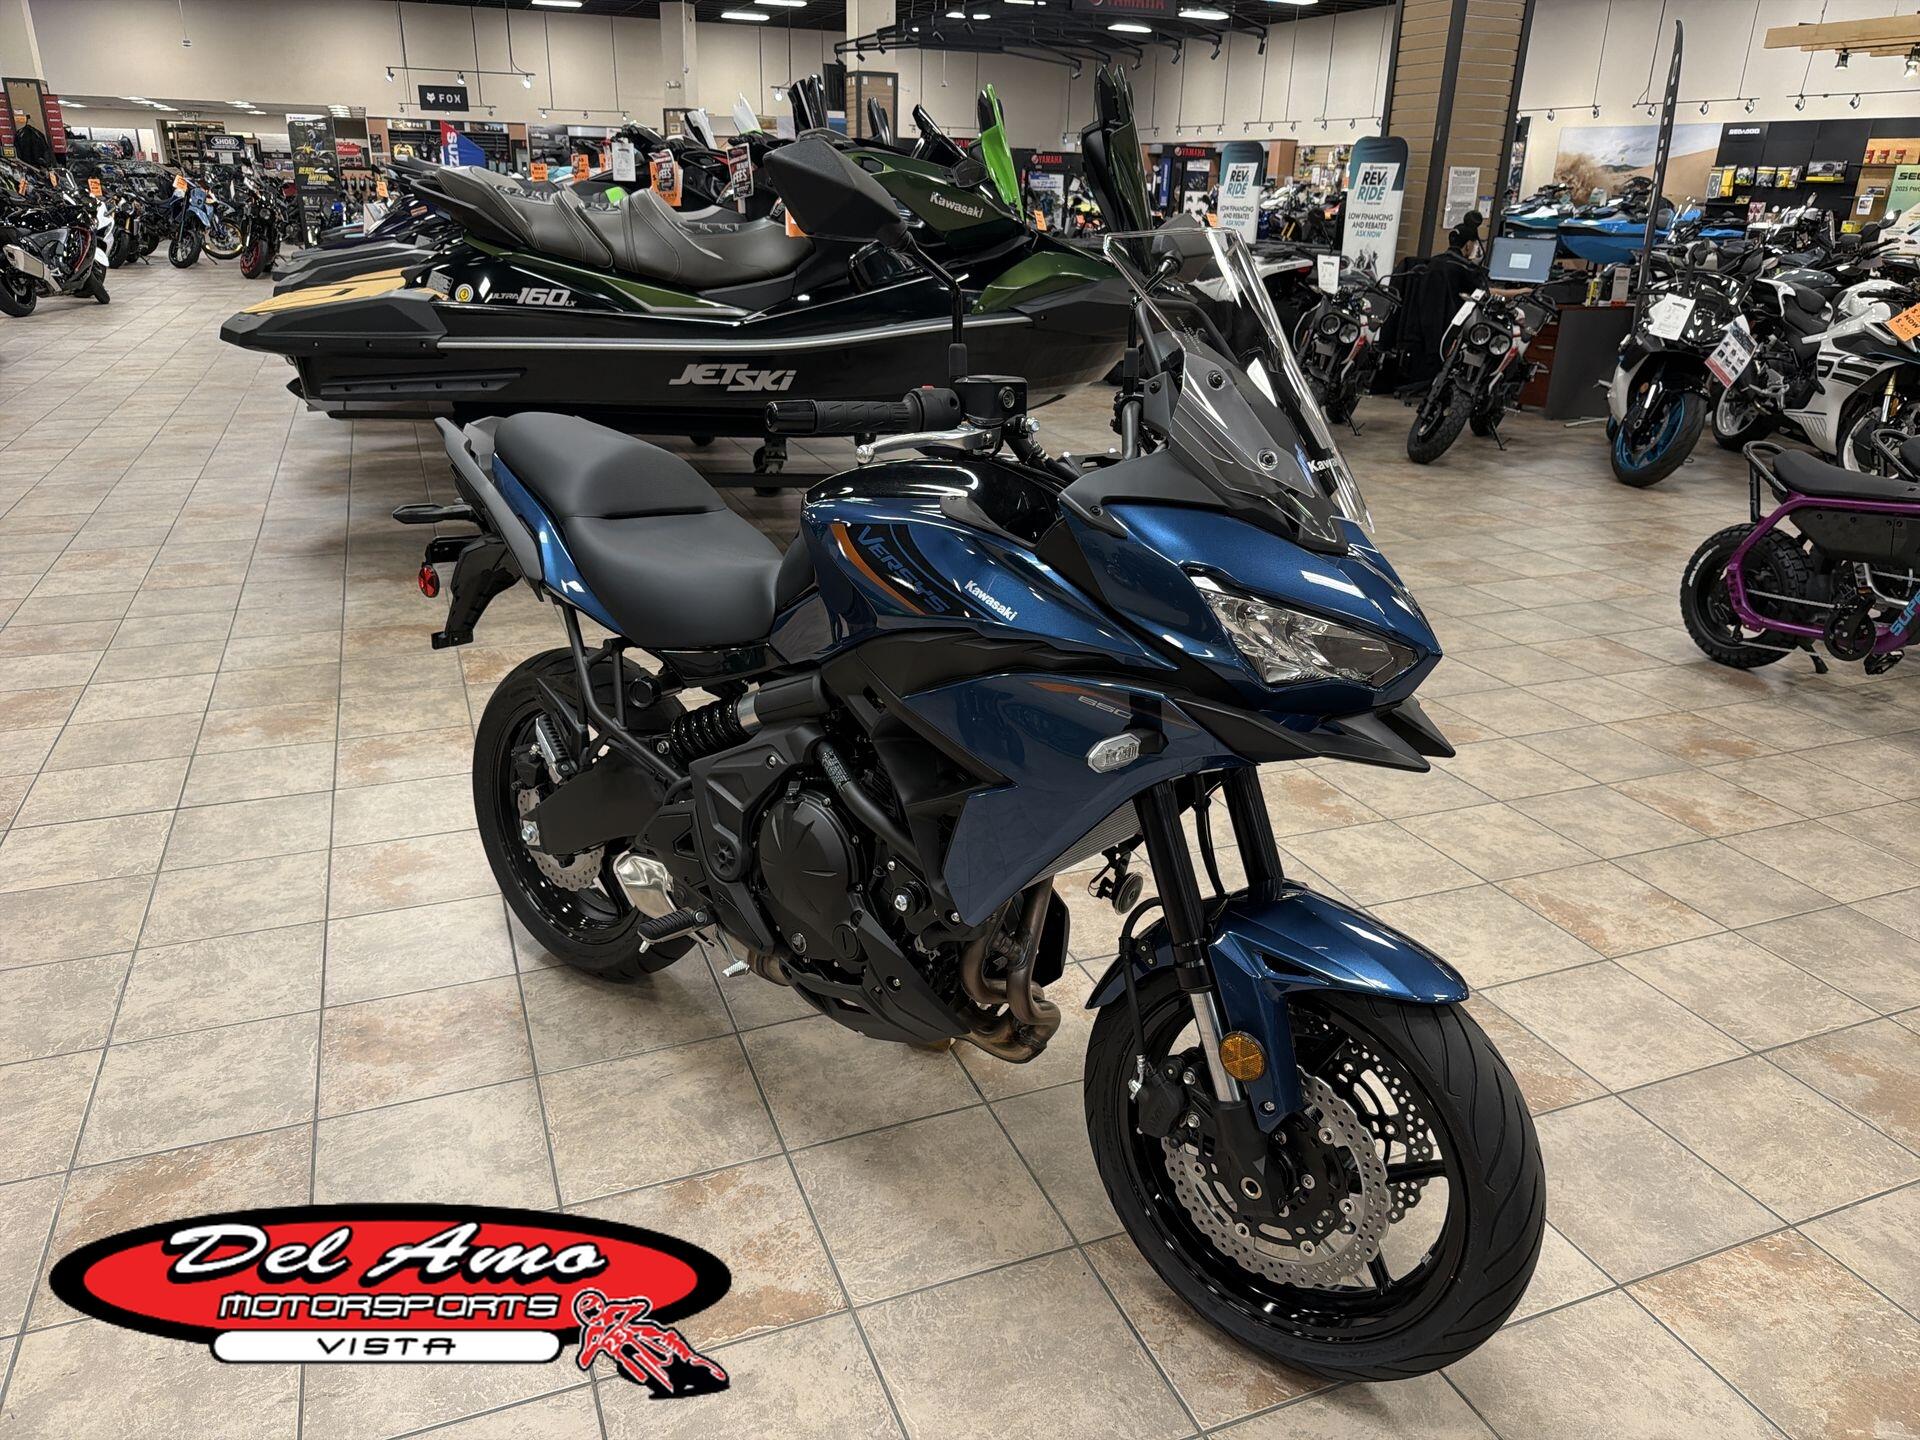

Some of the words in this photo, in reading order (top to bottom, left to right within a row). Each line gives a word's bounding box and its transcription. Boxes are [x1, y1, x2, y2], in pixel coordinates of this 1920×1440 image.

[438, 93, 462, 104] FOX
[1181, 147, 1206, 157] YAMAHA
[1038, 155, 1063, 164] YAMAHA
[732, 170, 747, 182] FEES
[1230, 170, 1249, 182] REV
[1361, 171, 1388, 186] REV
[1226, 183, 1248, 198] RIDE
[1356, 187, 1386, 202] RIDE
[929, 191, 985, 219] Kawasaki
[1348, 212, 1361, 220] LOW
[1361, 213, 1394, 222] FINANCING
[1351, 221, 1364, 229] AND
[1364, 222, 1388, 230] REBATES
[1355, 230, 1366, 238] ASK
[1366, 230, 1382, 238] NOW
[492, 292, 519, 300] ULTRA
[516, 287, 571, 306] 160
[858, 525, 951, 613] VERSYS
[964, 580, 1018, 621] Kawasaki
